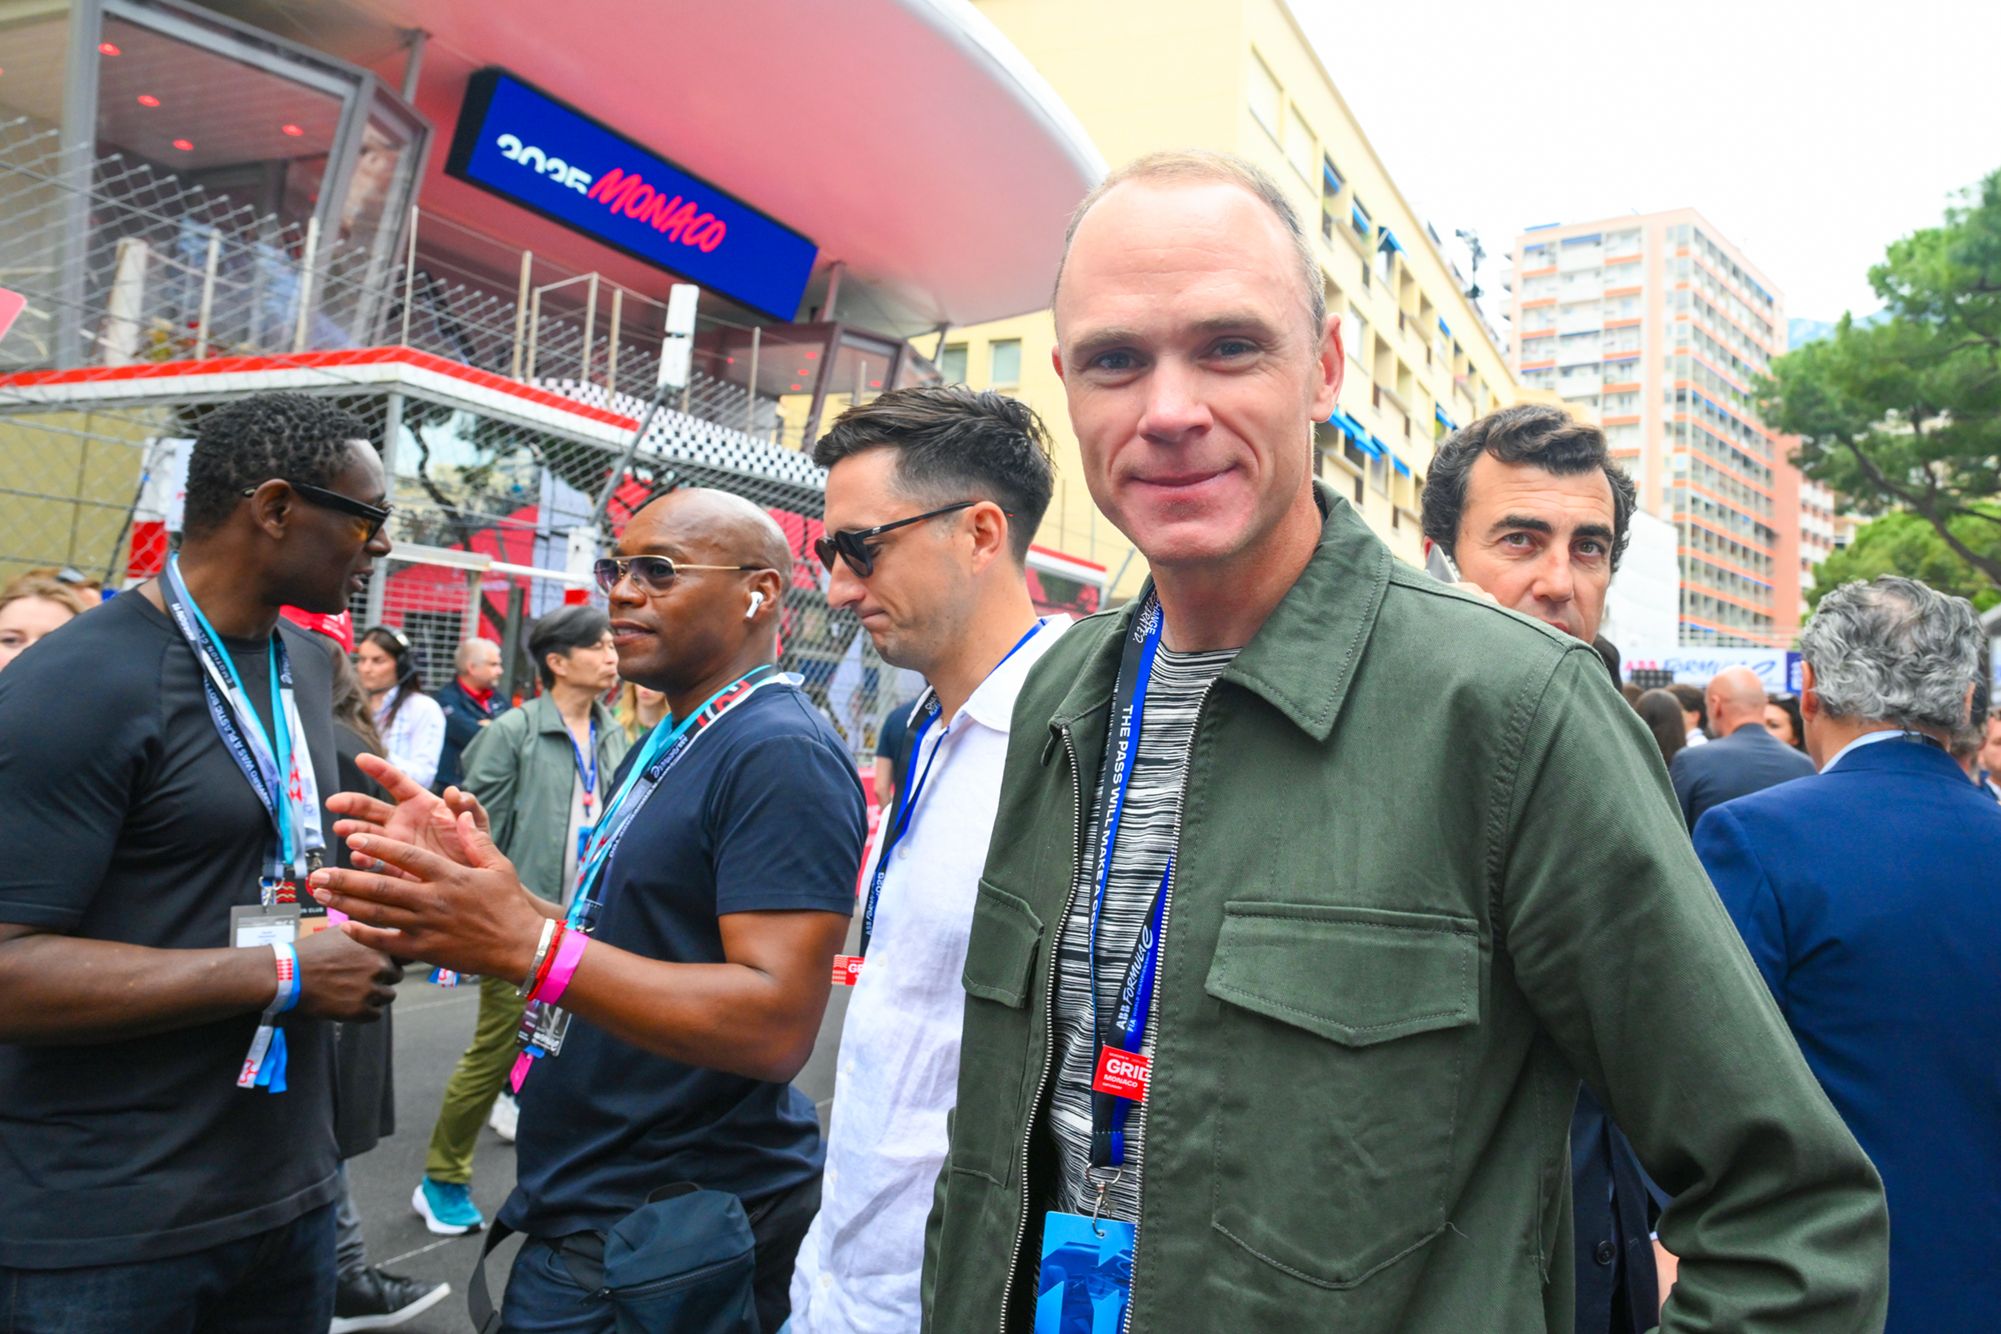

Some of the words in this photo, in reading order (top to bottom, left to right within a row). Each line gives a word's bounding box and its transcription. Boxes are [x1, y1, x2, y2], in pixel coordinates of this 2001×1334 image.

[587, 167, 728, 253] MONACO
[1119, 705, 1134, 737] THE
[1113, 742, 1129, 784] PASS
[1104, 787, 1121, 828] WILL
[1096, 830, 1111, 880] MAKE
[1094, 887, 1101, 897] A
[1122, 946, 1147, 1005] FORMULA
[1116, 1004, 1131, 1030] ABB
[1127, 1019, 1137, 1033] FIA
[1103, 1074, 1139, 1088] MONACO
